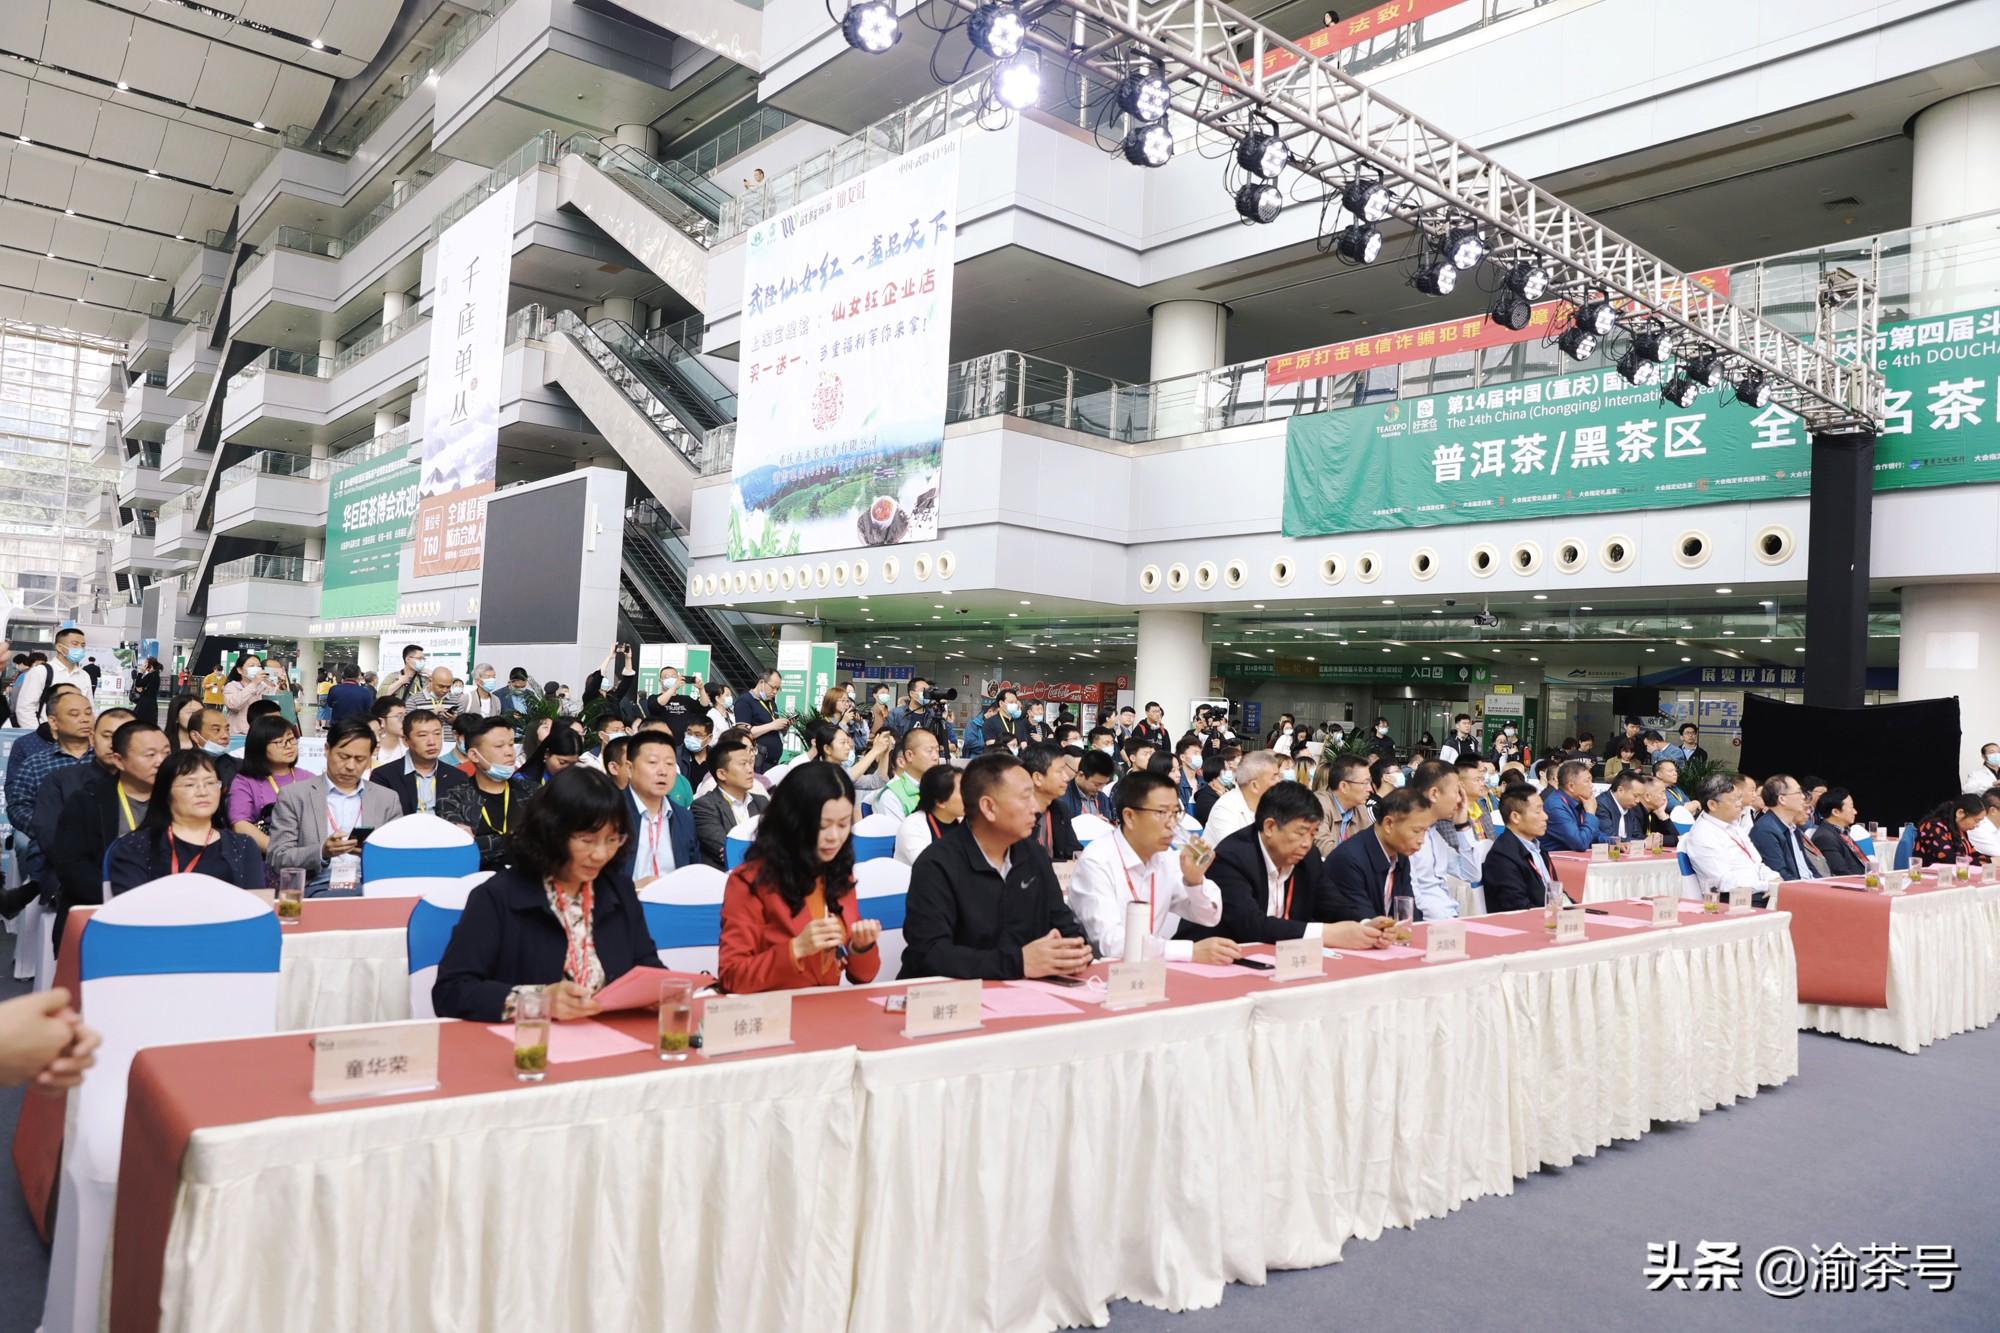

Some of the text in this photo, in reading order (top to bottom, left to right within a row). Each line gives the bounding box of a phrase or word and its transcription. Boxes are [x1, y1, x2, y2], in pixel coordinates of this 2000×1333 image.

[450, 255, 481, 426] 千庭单丛
[1276, 321, 1481, 373] 严厉打击电信诈骗犯罪
[1891, 352, 1921, 368] 4th
[1446, 417, 1466, 429] The
[1468, 414, 1492, 426] 14th
[1495, 409, 1527, 423] China
[1529, 399, 1601, 421] (Chongqing)
[1376, 423, 1407, 433] TEAEXPO
[1432, 413, 1706, 483] 普洱茶/黑茶区
[342, 484, 420, 534] 华巨臣茶博会欢迎
[1410, 666, 1431, 680] 入口
[1701, 668, 1805, 684] 展览现场服
[345, 1055, 408, 1080] 童华荣
